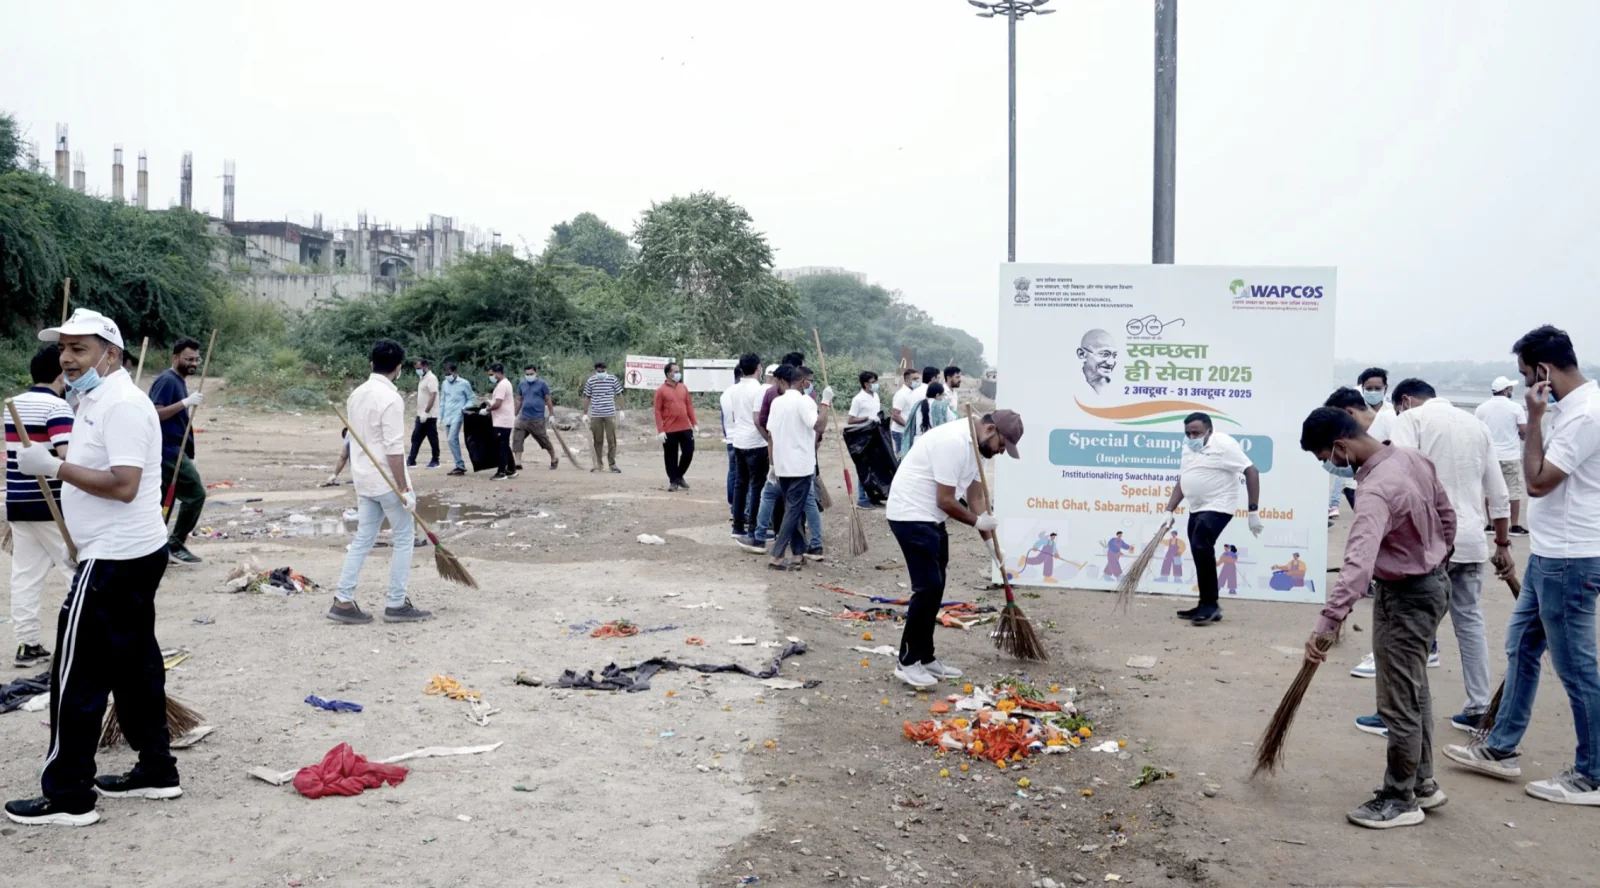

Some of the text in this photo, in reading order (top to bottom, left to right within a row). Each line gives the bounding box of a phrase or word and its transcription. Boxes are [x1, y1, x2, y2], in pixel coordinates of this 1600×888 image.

[1251, 285, 1323, 298] WAPCOS
[1126, 343, 1209, 359] स्वच्छता
[1124, 360, 1252, 382] ही सेवा 2025
[1124, 386, 1130, 395] 2
[1177, 388, 1188, 396] 31
[1228, 389, 1252, 398] 2025
[1069, 432, 1128, 449] Special
[1133, 434, 1182, 452] Camp
[1062, 470, 1123, 481] Institutionalizing
[1125, 472, 1164, 481] Swachhata
[1121, 485, 1161, 498] Special
[1027, 498, 1059, 510] Chhat
[1062, 499, 1090, 512] Ghat,
[1094, 501, 1152, 514] Sabarmati,
